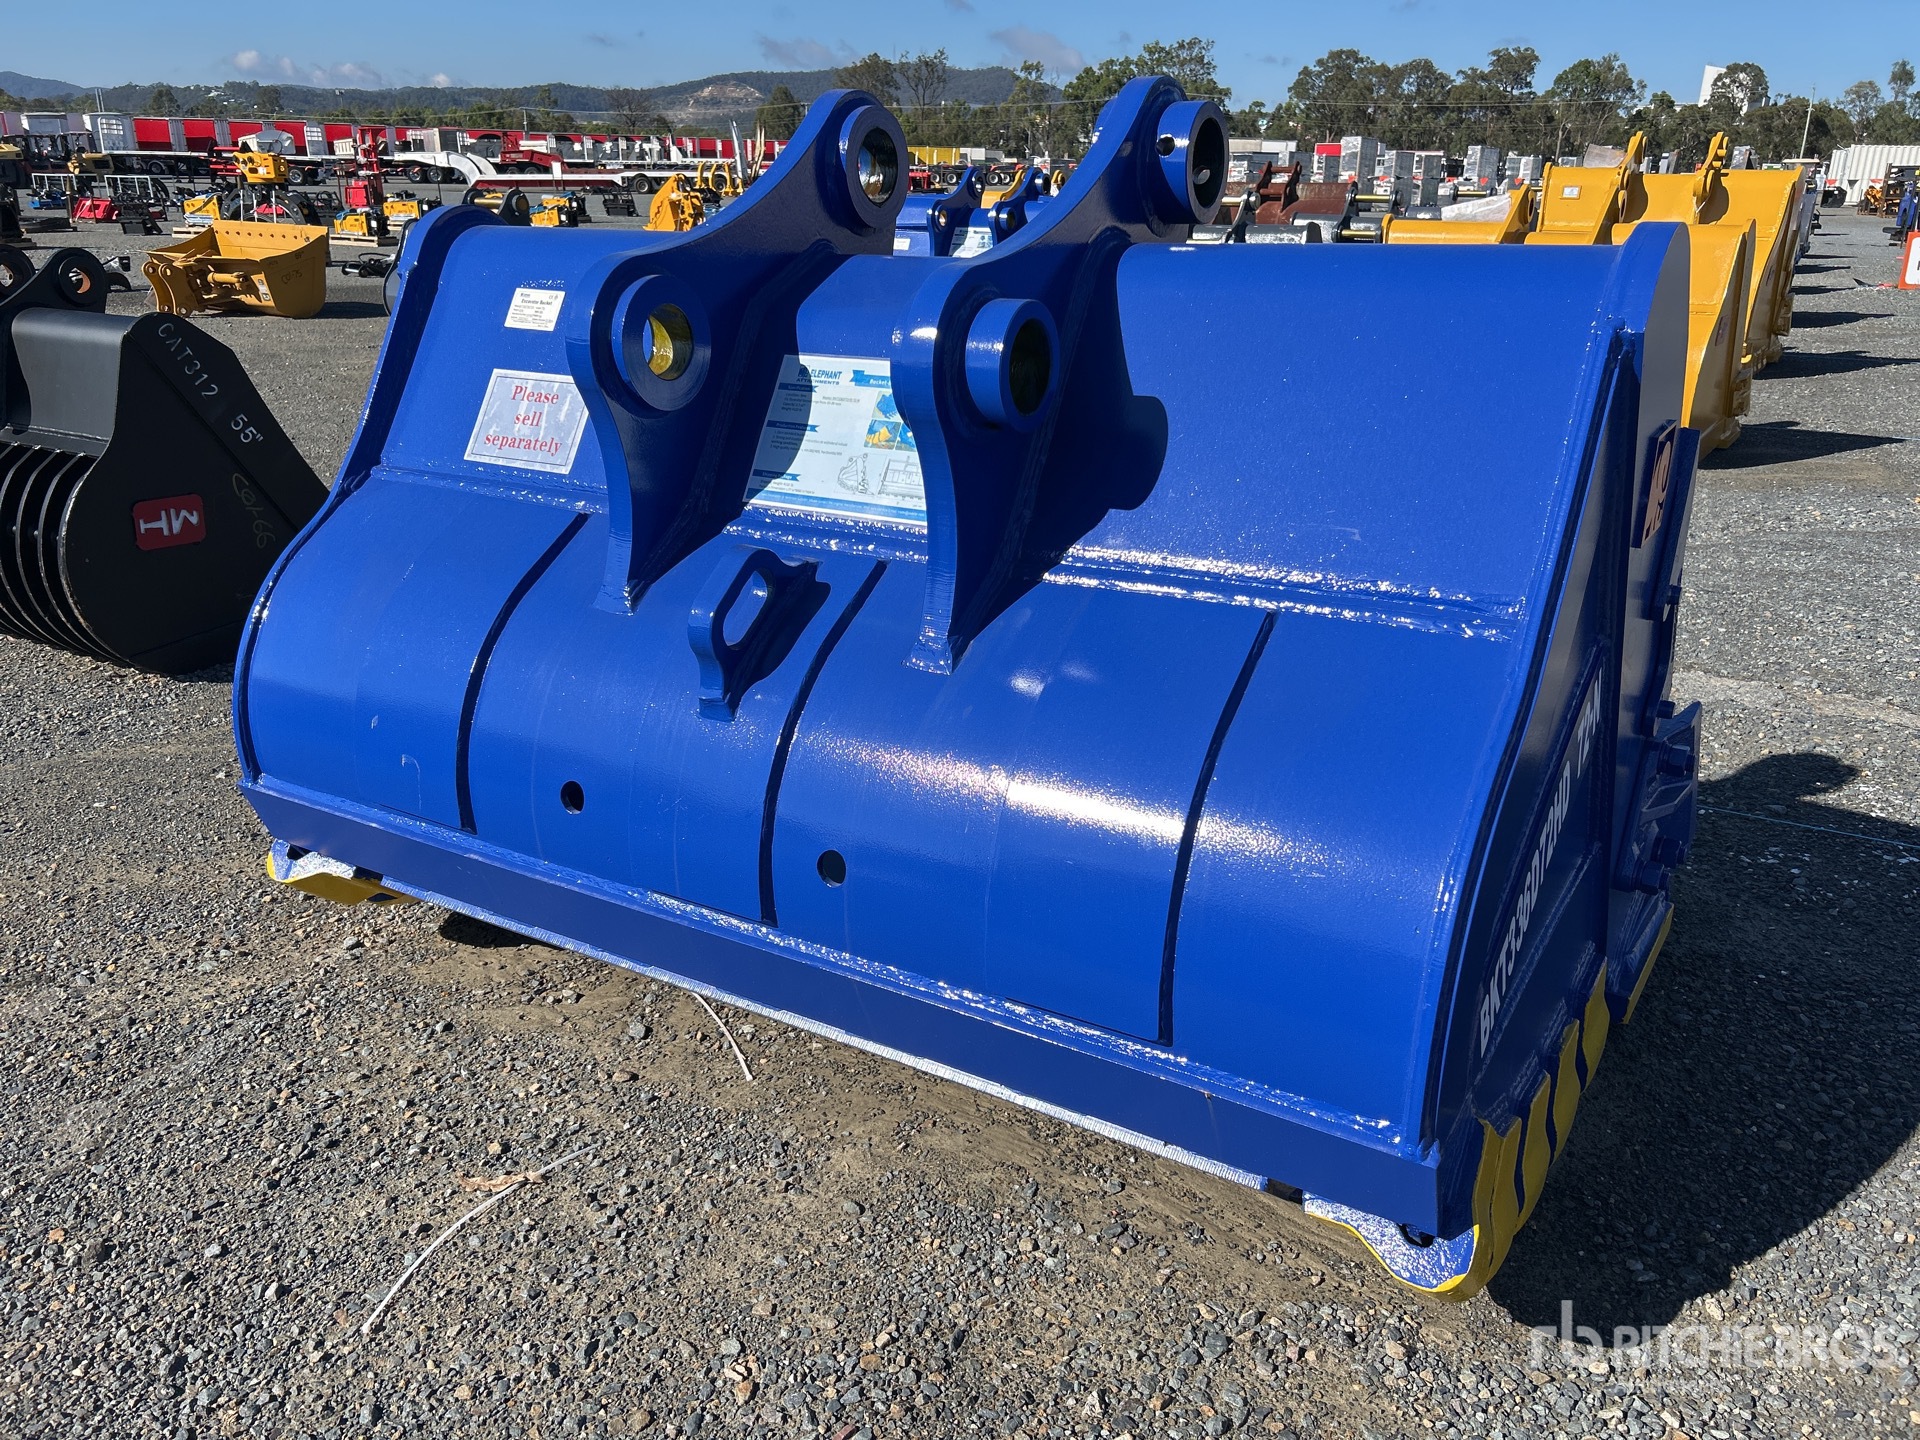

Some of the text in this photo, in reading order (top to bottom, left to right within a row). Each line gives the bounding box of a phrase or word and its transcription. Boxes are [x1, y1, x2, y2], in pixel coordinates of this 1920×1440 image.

[156, 321, 264, 445] CAT312 55"
[796, 378, 840, 387] ATTACHMENTS
[810, 368, 843, 381] ELEPHANT
[511, 384, 559, 404] Please
[514, 411, 543, 427] sell
[484, 432, 562, 456] separately
[1479, 666, 1602, 1058] BKT336D72HD 72-N
